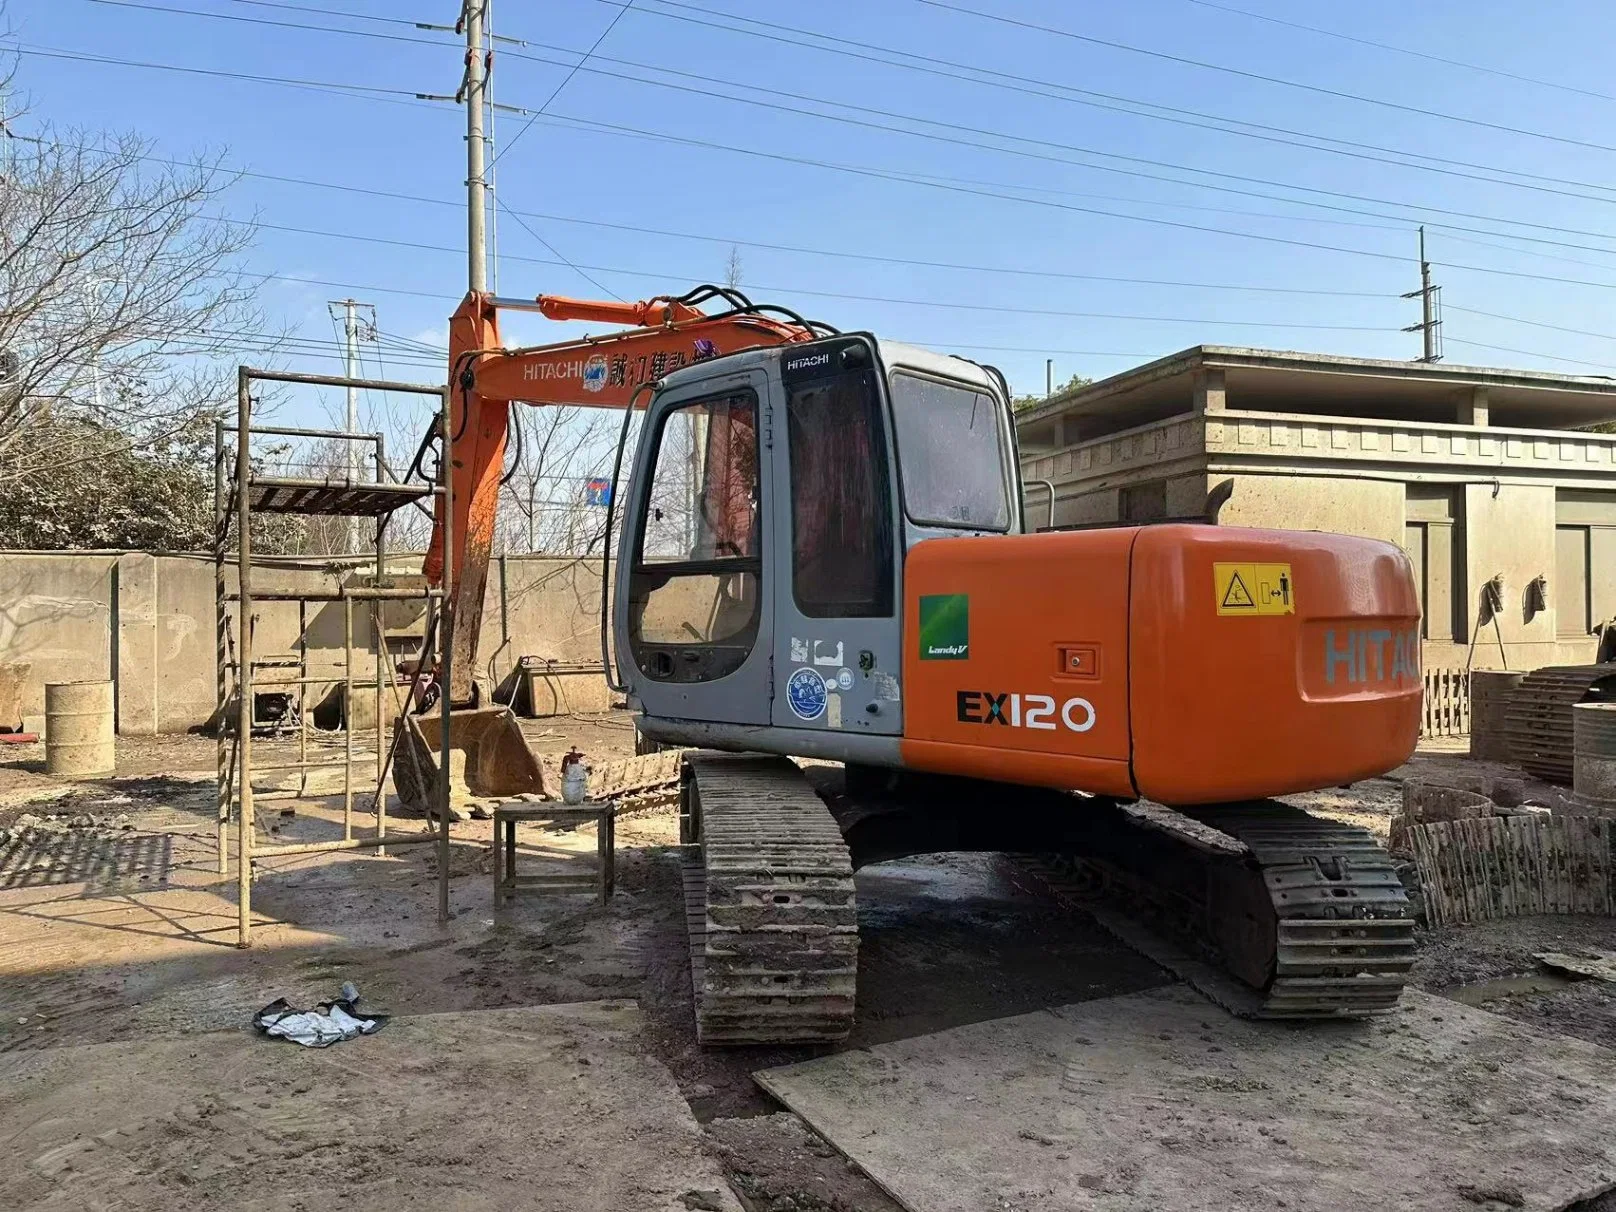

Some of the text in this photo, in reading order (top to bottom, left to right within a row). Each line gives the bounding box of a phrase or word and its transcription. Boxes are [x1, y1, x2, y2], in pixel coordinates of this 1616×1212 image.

[524, 360, 583, 380] HITACHI
[787, 353, 829, 371] HITACHI
[956, 690, 1096, 732] EX120
